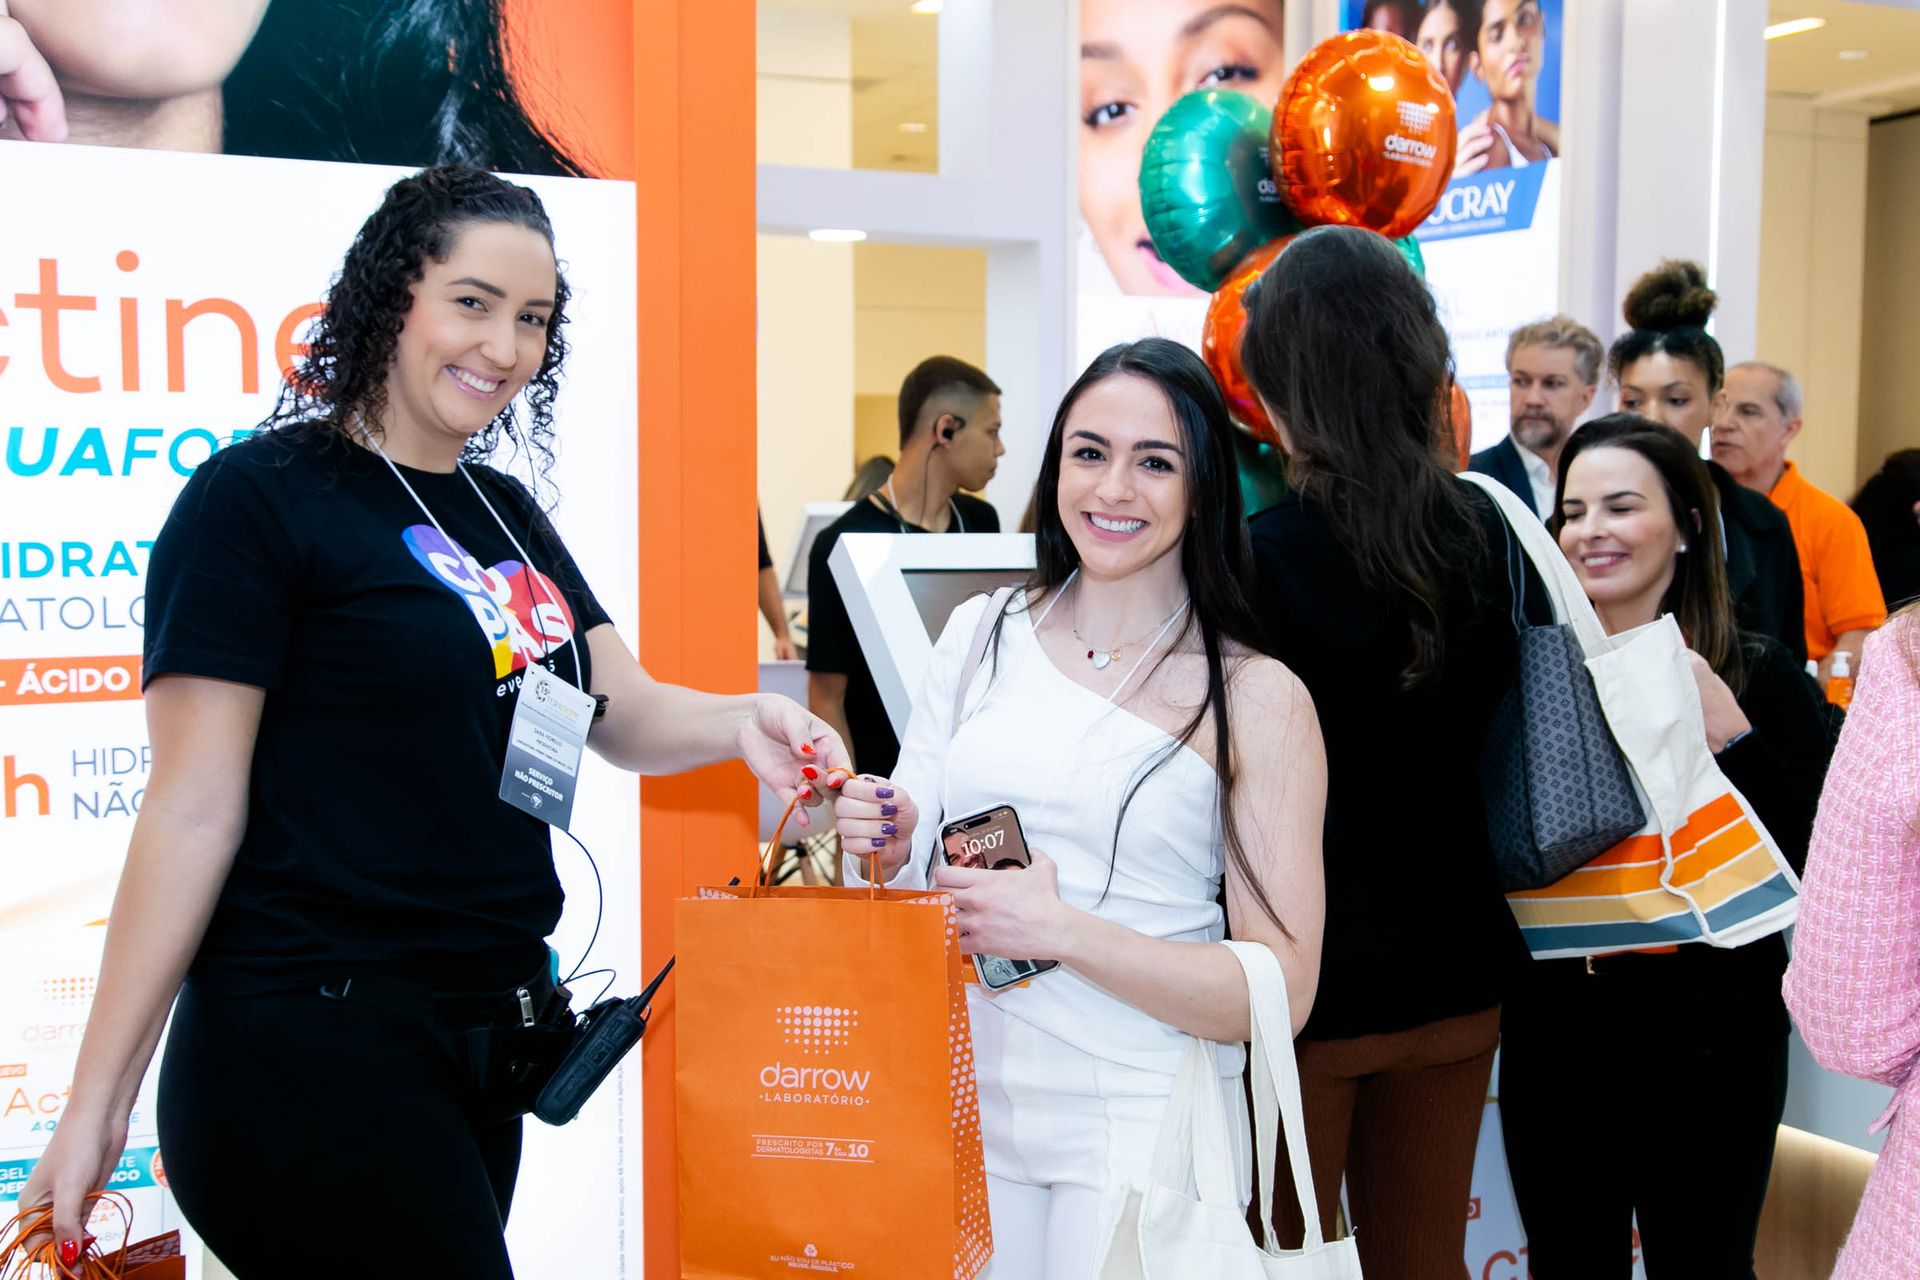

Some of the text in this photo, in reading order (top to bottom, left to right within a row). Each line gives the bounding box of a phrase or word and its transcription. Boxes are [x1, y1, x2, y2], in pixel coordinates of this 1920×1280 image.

[1384, 132, 1437, 159] darrow
[0, 250, 330, 396] tine
[16, 663, 131, 695] ÁCIDO
[515, 770, 564, 802] NÃO PRESCRITOR
[528, 767, 554, 786] SERVIÇO
[961, 830, 1005, 857] 10:07
[760, 1061, 870, 1091] darrow
[756, 1139, 804, 1148] PRESCRITO
[756, 1146, 824, 1155] DERMATOLOGISTAS
[825, 1142, 835, 1156] 7
[848, 1144, 869, 1158] 10
